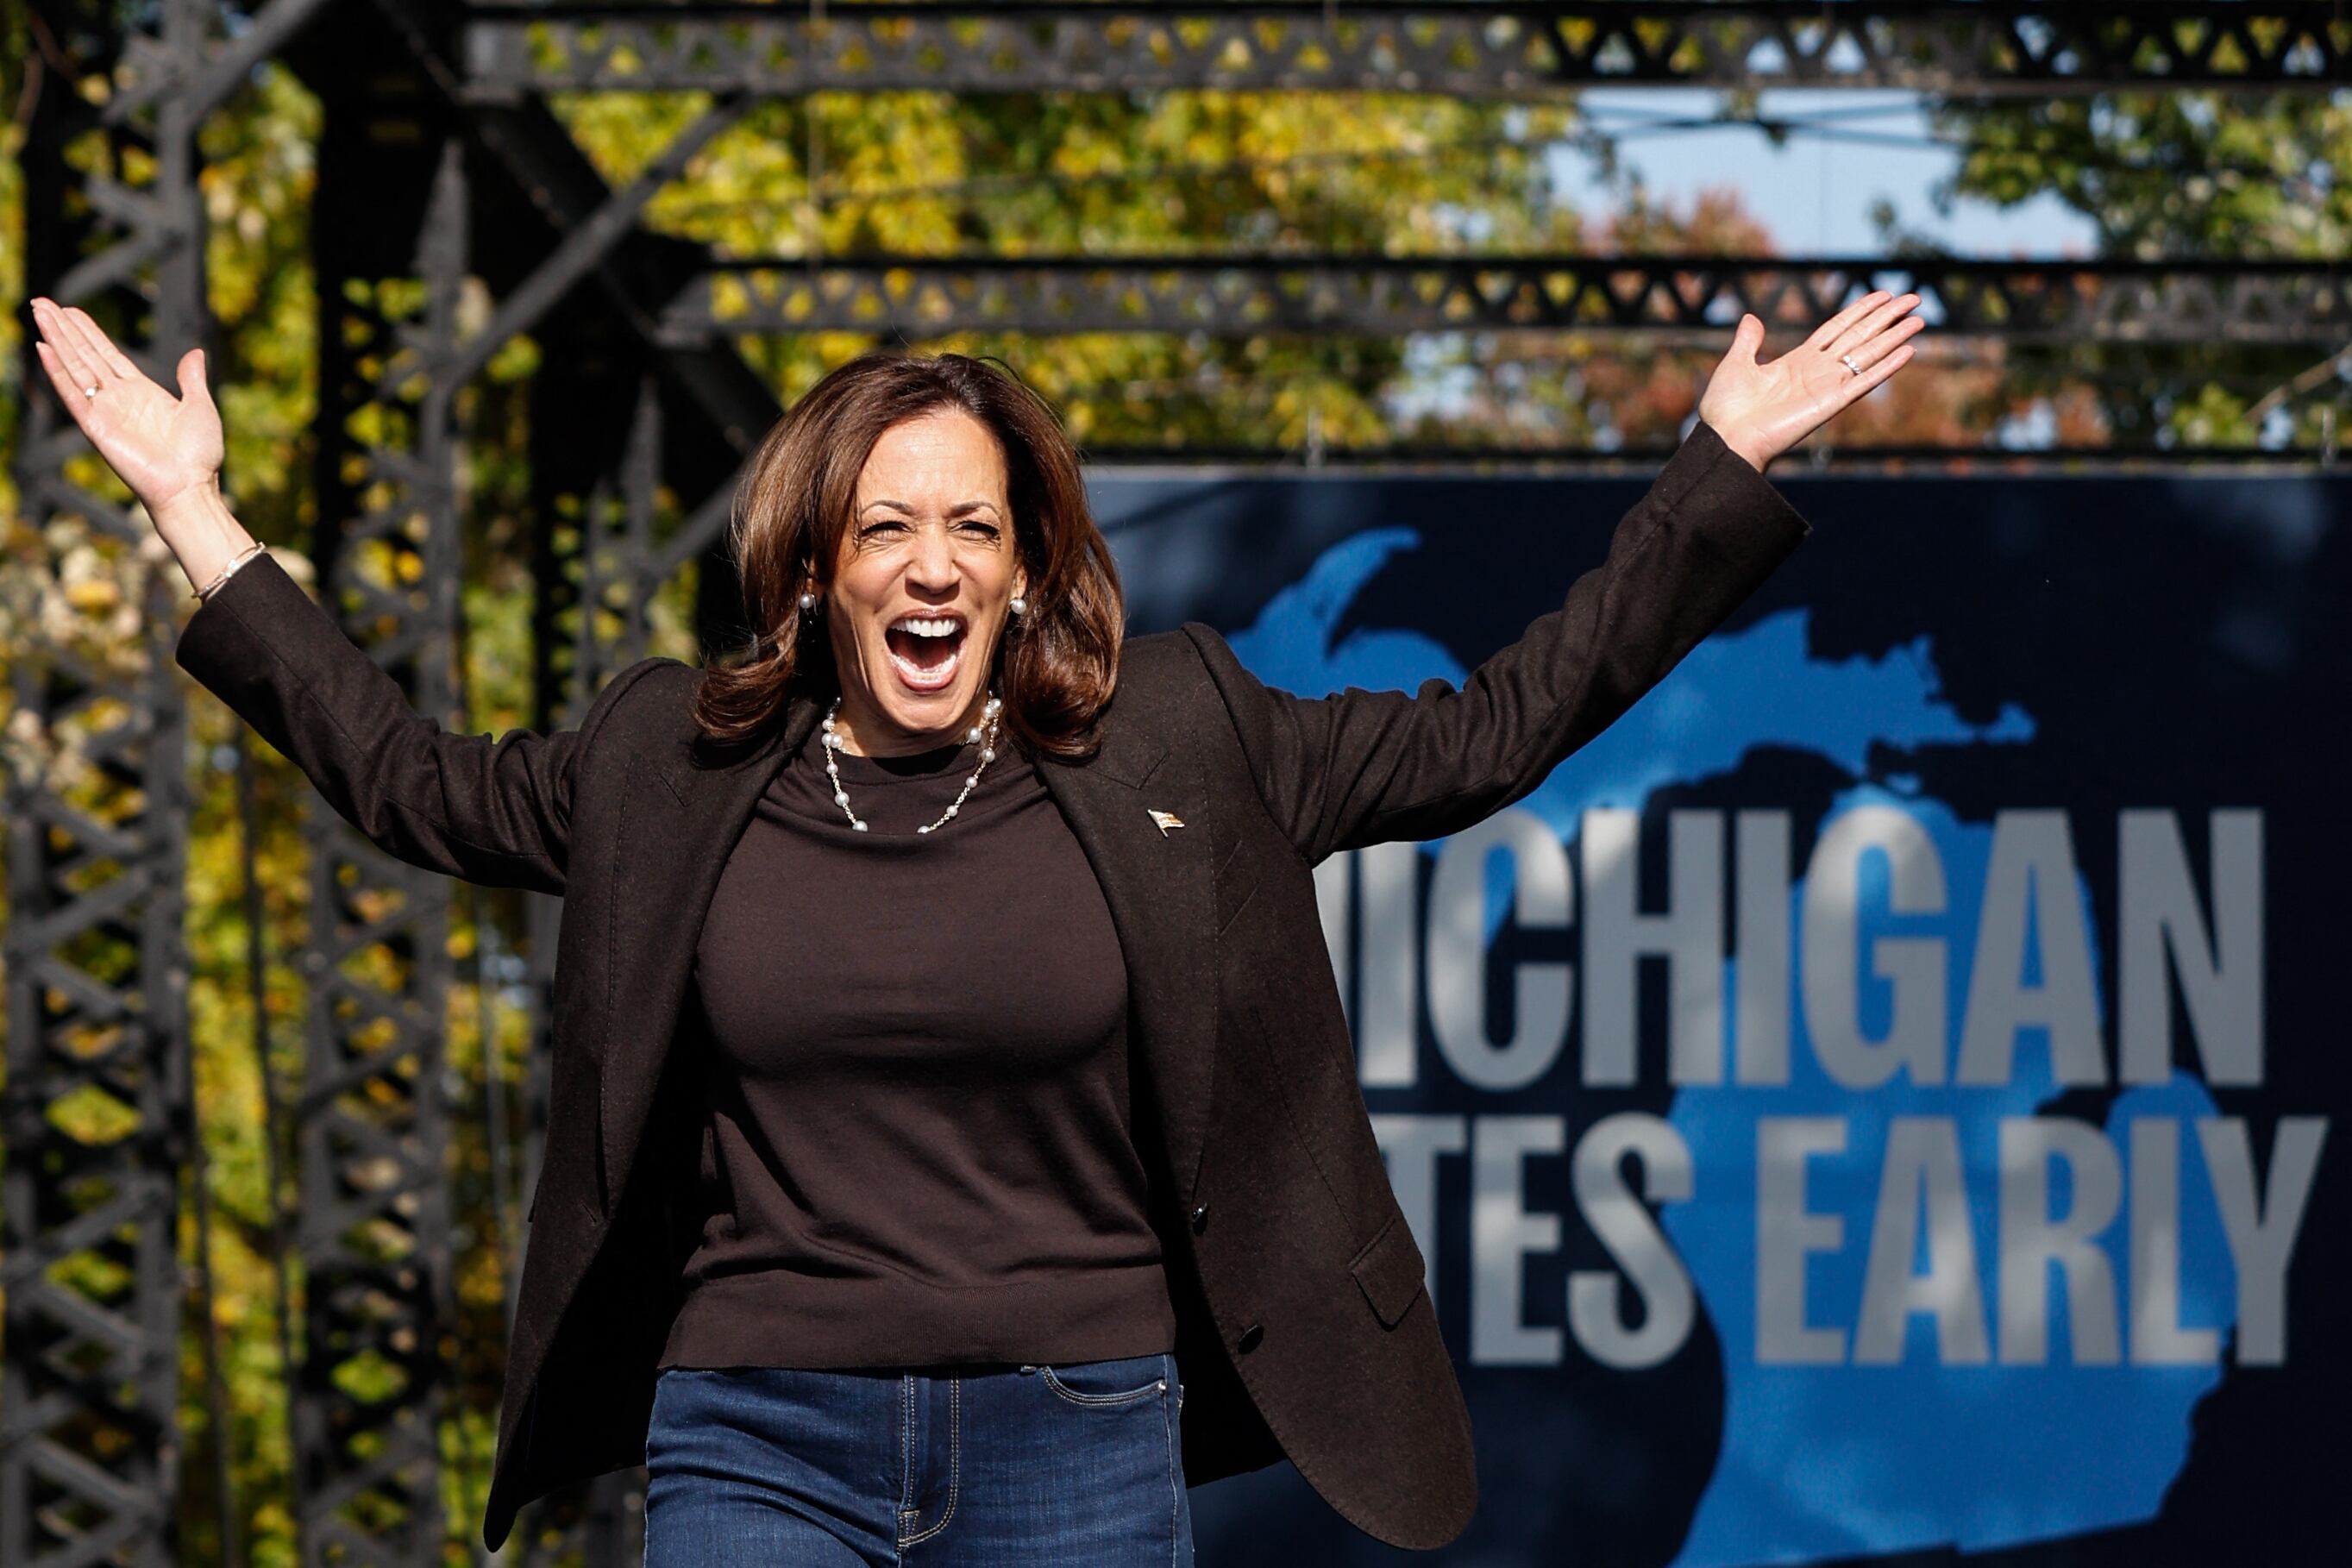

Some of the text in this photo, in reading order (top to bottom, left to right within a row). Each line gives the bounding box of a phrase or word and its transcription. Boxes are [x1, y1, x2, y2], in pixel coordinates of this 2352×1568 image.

[1312, 805, 2263, 1089] ICHIGAN
[1366, 1113, 2328, 1370] TES EARLY
